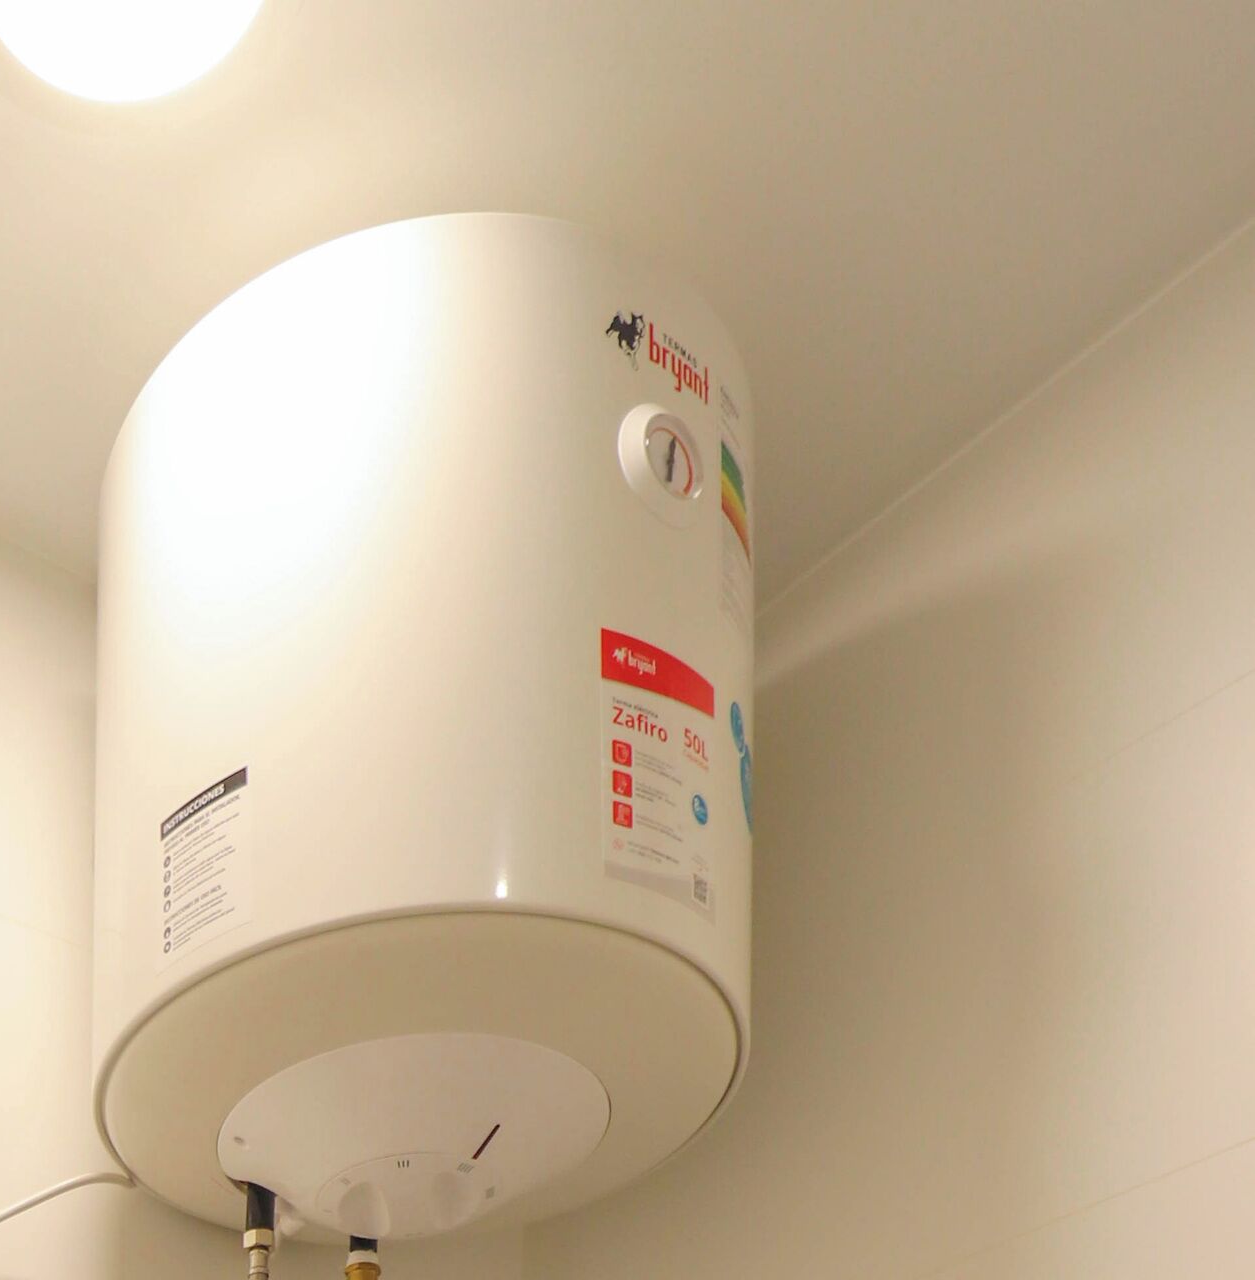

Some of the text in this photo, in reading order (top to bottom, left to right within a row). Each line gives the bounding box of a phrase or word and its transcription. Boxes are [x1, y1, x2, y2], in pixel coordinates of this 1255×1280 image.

[649, 321, 709, 405] bryant
[612, 705, 668, 743] Zafiro
[683, 727, 709, 762] 50L
[163, 783, 225, 834] INSTRUCCIONES
